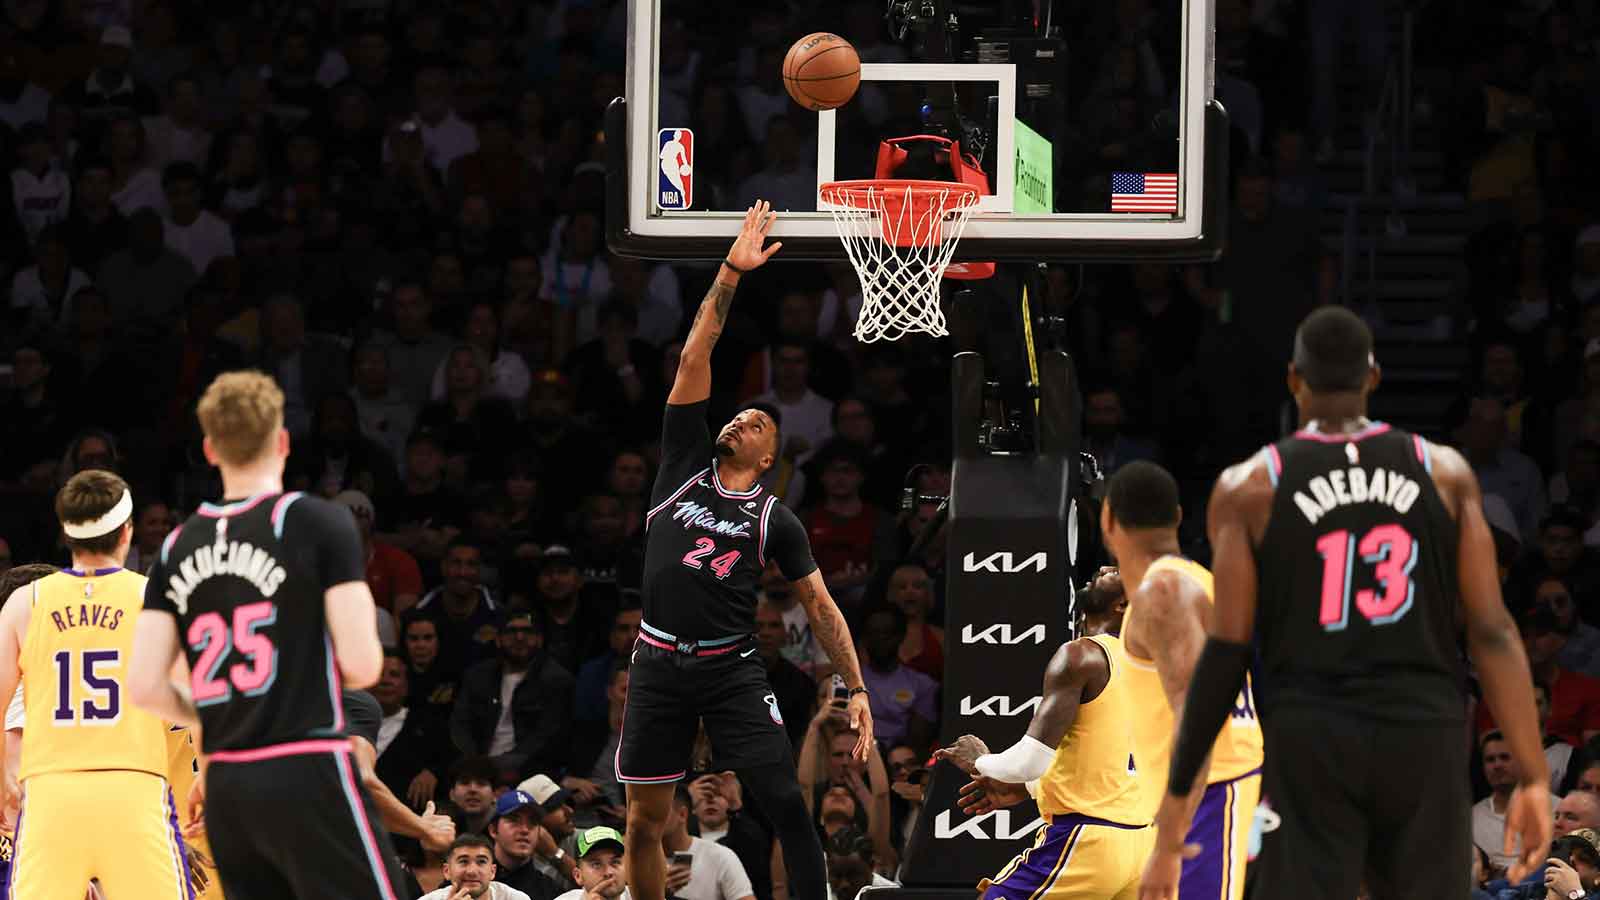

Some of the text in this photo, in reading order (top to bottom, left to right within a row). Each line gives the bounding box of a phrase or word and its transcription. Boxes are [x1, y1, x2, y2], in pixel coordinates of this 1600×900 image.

[662, 191, 679, 205] NBA
[1293, 467, 1420, 525] ADEBAYO
[672, 501, 752, 537] Miami
[681, 536, 742, 580] 24
[963, 551, 1047, 572] KIA
[1315, 523, 1419, 631] 13
[51, 604, 124, 632] REAVES
[961, 623, 1046, 644] KIA
[187, 601, 278, 707] 25
[53, 649, 121, 723] 15
